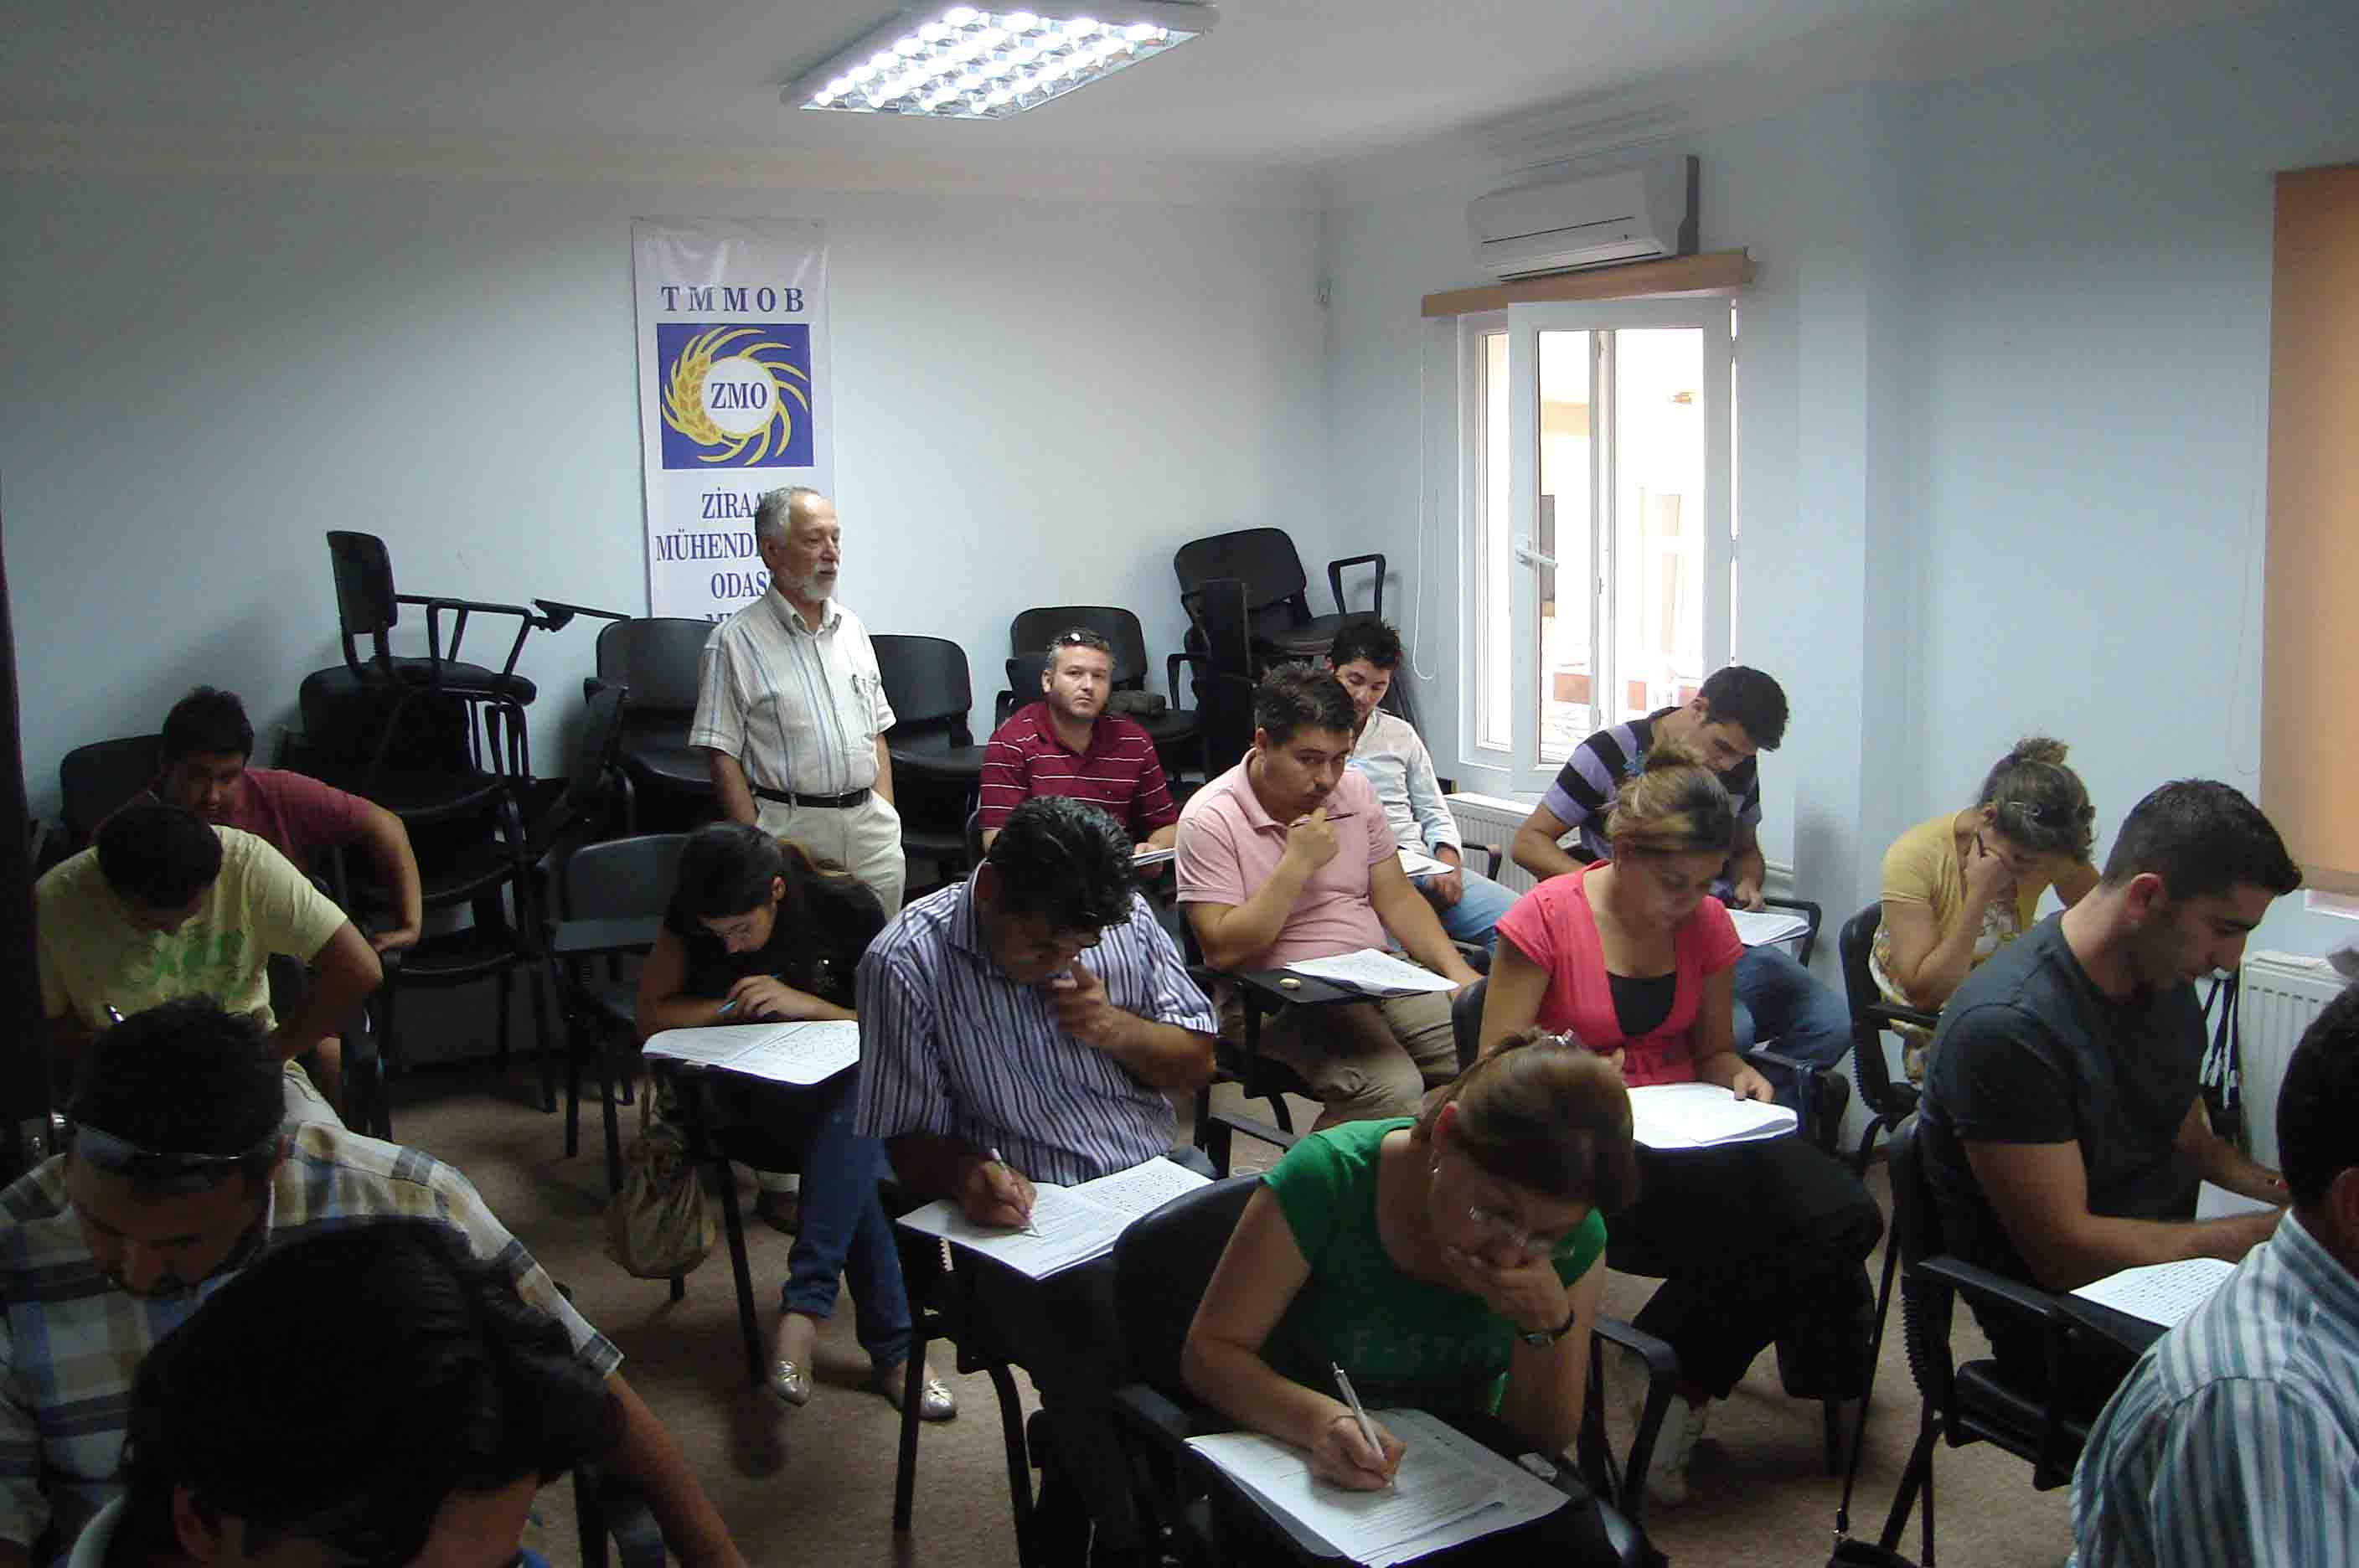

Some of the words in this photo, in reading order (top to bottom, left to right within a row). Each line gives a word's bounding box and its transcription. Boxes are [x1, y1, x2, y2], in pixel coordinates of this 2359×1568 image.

[661, 286, 805, 312] TMMOB
[710, 382, 767, 410] ZMO
[702, 486, 766, 519] ZİRAA
[656, 527, 760, 561] MÜHEND
[711, 570, 767, 600] ODAS
